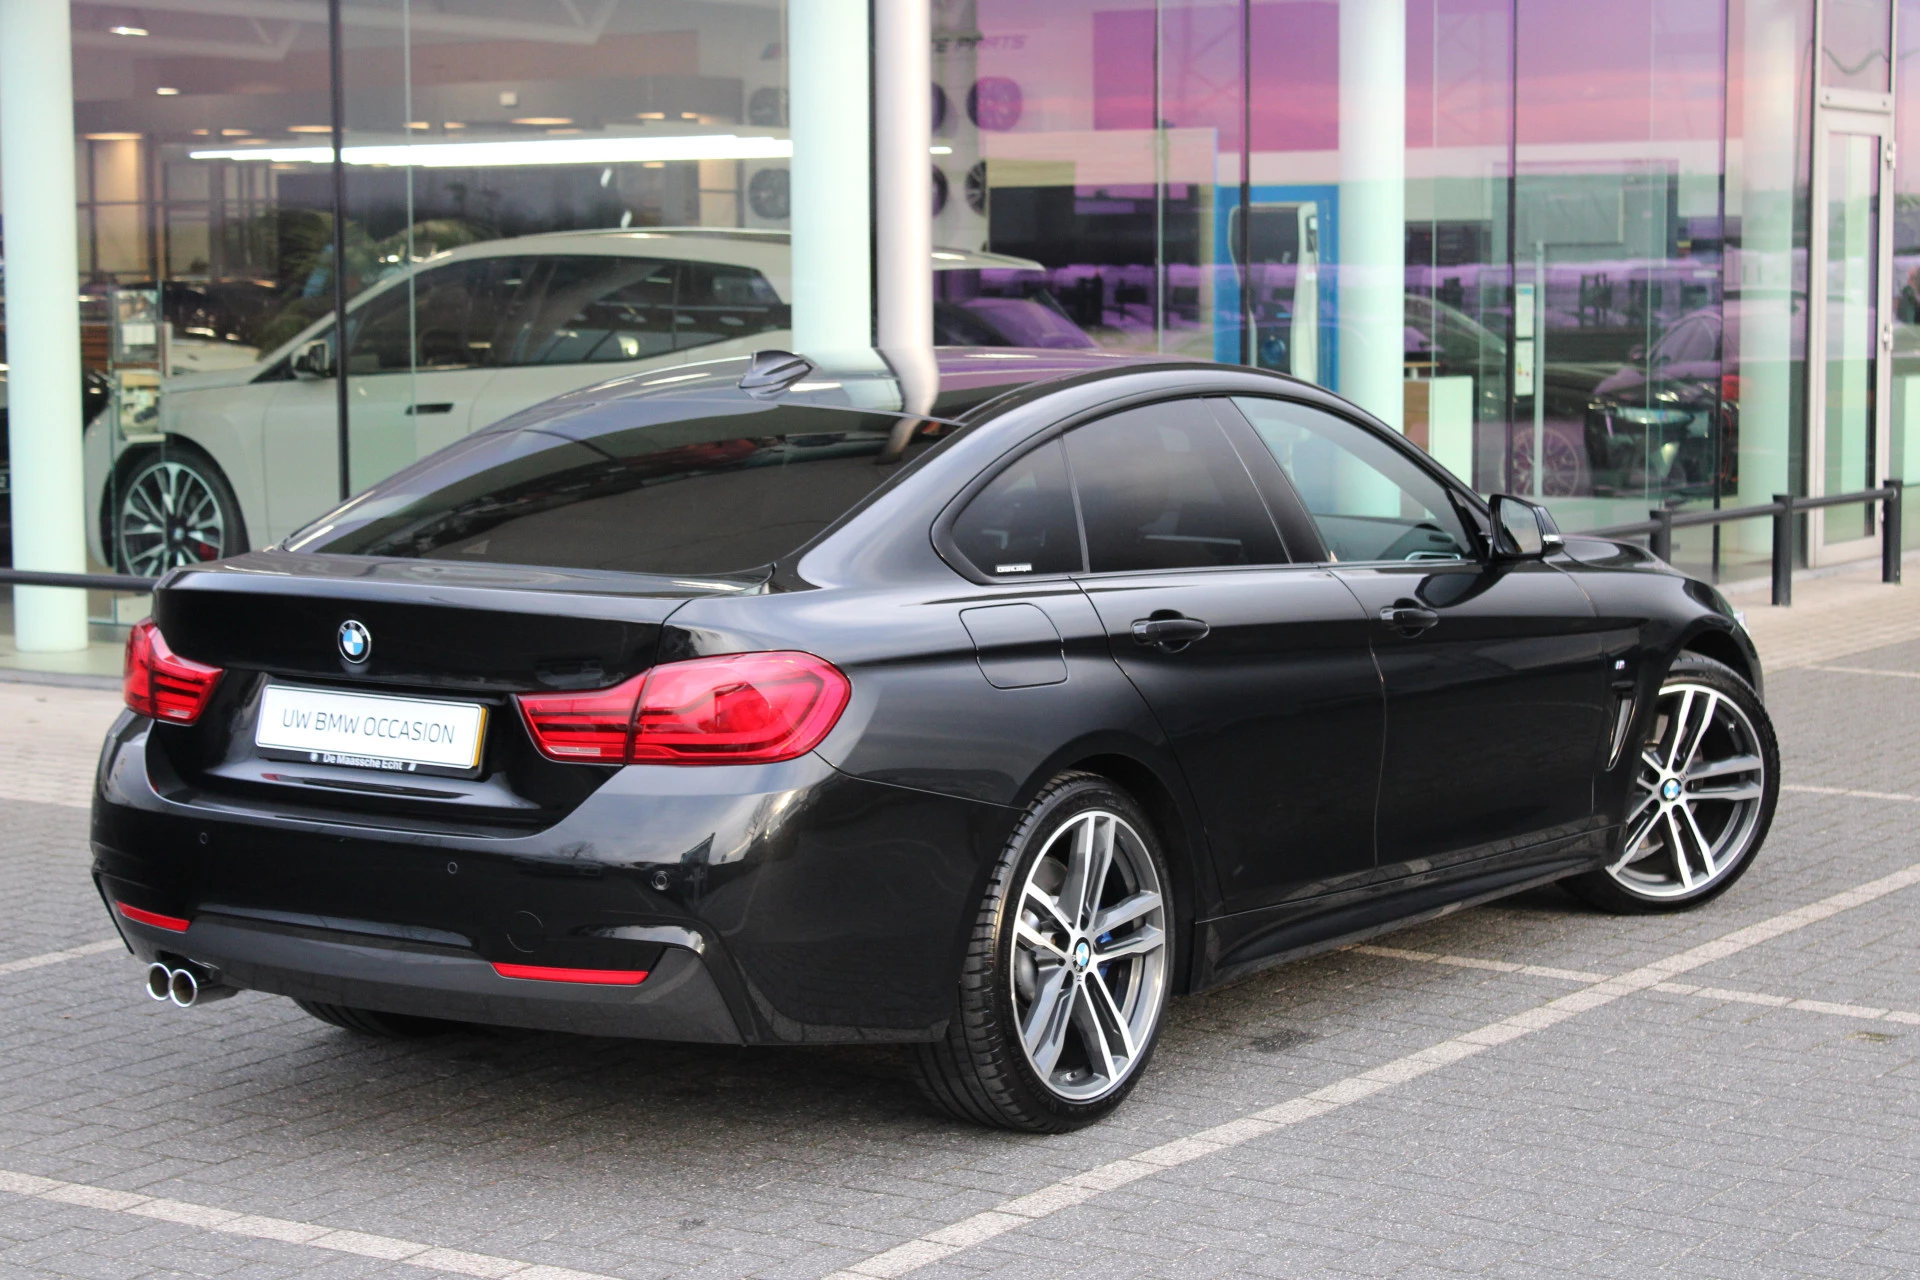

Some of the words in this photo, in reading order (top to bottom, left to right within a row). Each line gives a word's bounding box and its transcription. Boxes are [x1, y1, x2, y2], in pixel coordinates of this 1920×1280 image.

[282, 708, 311, 730] UW
[315, 712, 360, 734] BMW
[363, 716, 455, 744] OCCASION
[323, 753, 336, 764] De
